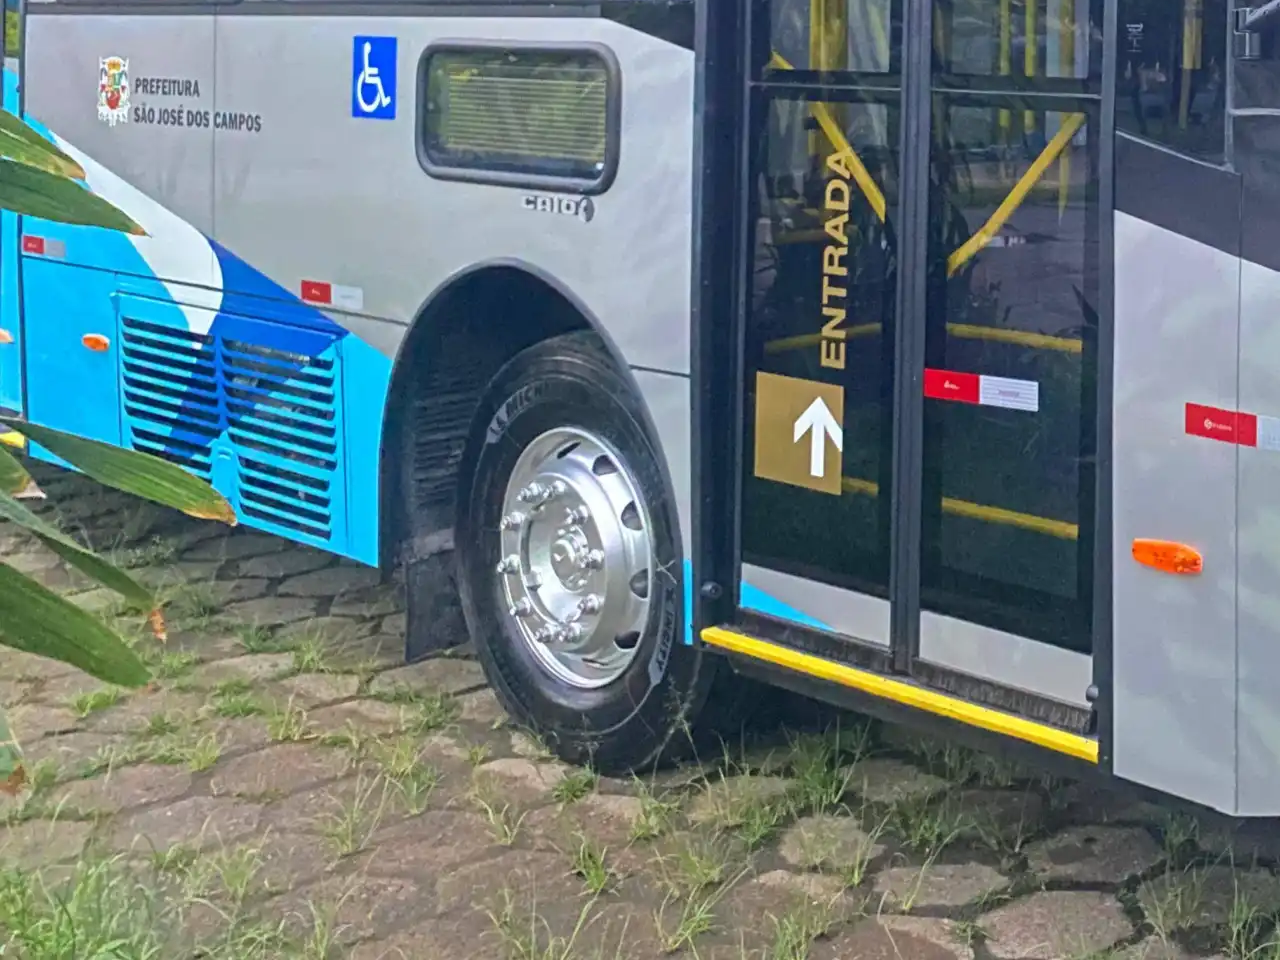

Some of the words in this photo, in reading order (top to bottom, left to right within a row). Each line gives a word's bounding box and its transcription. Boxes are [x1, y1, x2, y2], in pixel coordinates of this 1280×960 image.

[135, 78, 201, 97] PREFEITURA
[134, 103, 155, 123] SÃO
[157, 104, 184, 126] JOSÉ
[187, 110, 210, 128] DOS
[213, 112, 262, 132] CAMPOS
[521, 195, 577, 214] CAIO
[820, 147, 853, 369] ENTRADA
